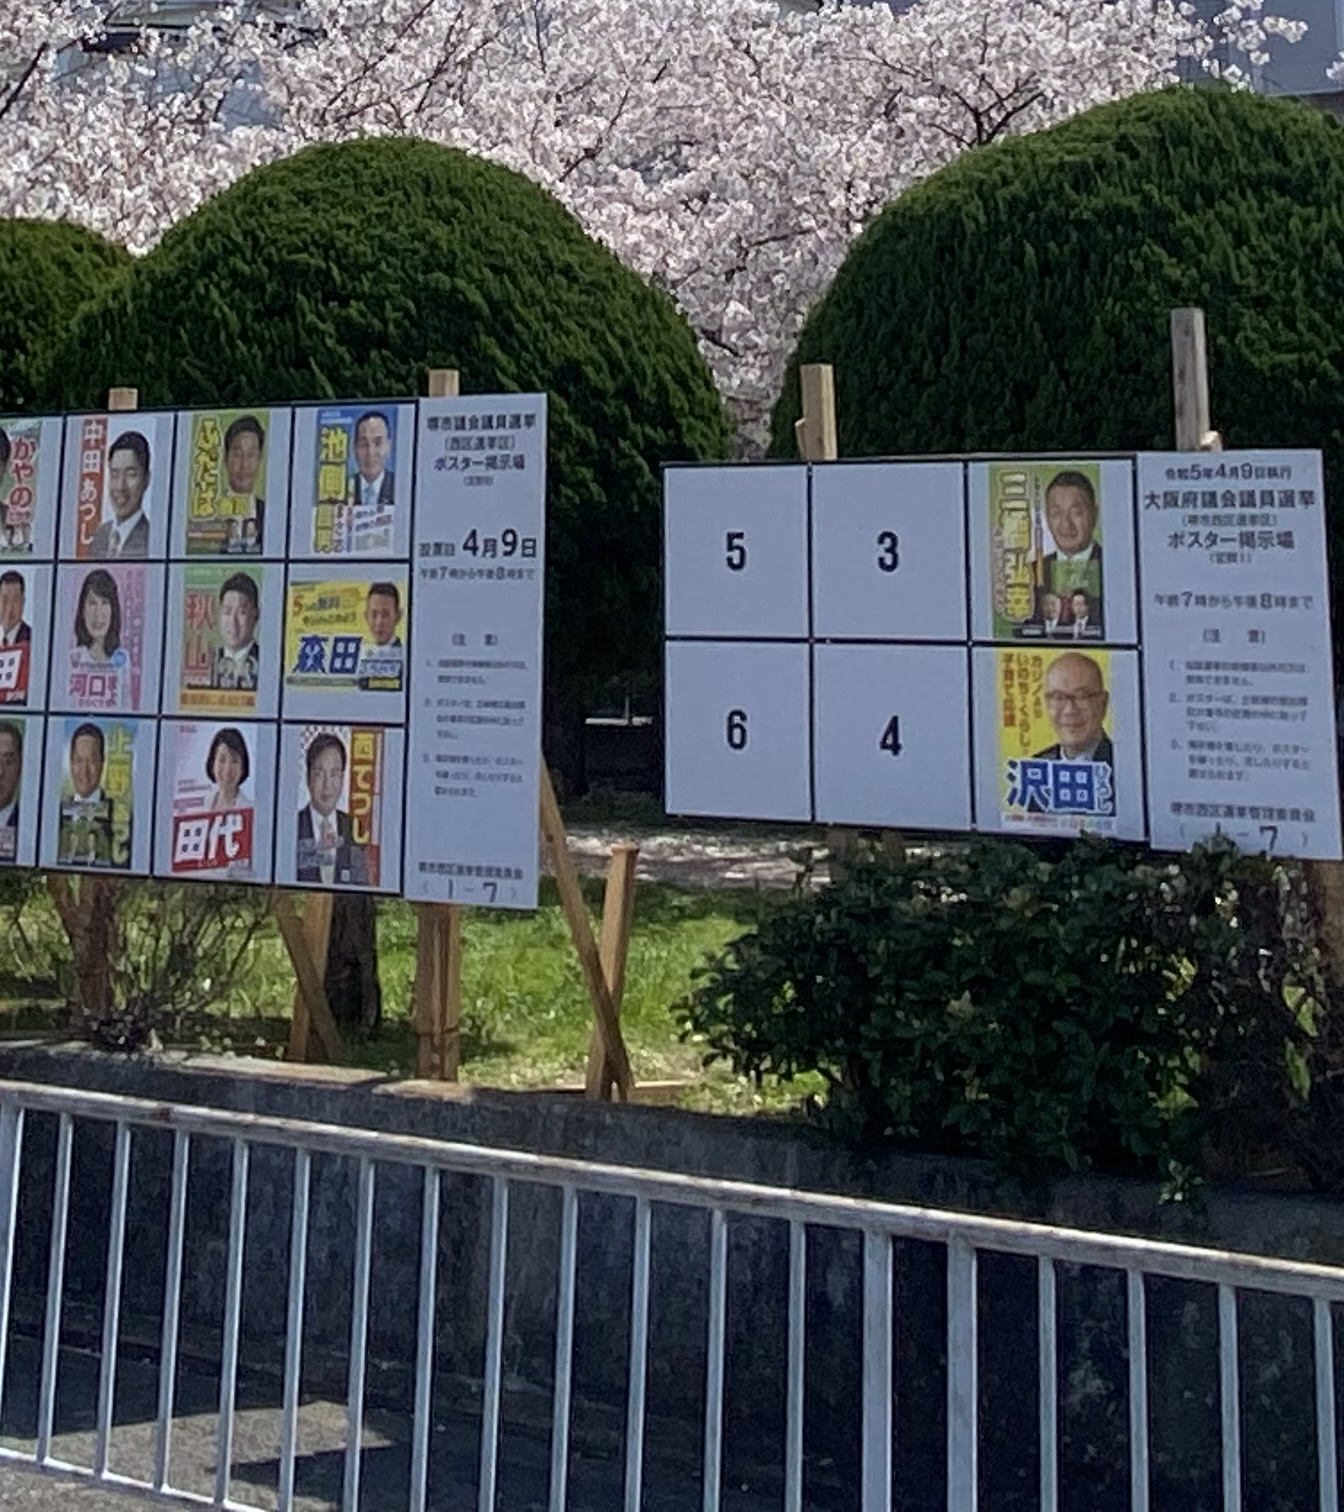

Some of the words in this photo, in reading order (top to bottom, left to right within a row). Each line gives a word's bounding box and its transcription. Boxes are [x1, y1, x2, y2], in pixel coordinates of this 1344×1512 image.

[433, 454, 526, 471] ポスター掲示場
[1166, 463, 1292, 481] 令和5年4月9日執行
[1144, 489, 1316, 510] 大阪府議会議員選挙
[462, 527, 537, 559] 4月9日
[726, 532, 747, 572] 5
[877, 531, 900, 572] 3
[1167, 530, 1295, 550] ポスター掲示場
[726, 709, 748, 750] 6
[879, 715, 903, 756] 4
[1006, 759, 1096, 812] 沢田
[174, 813, 244, 863] 田代
